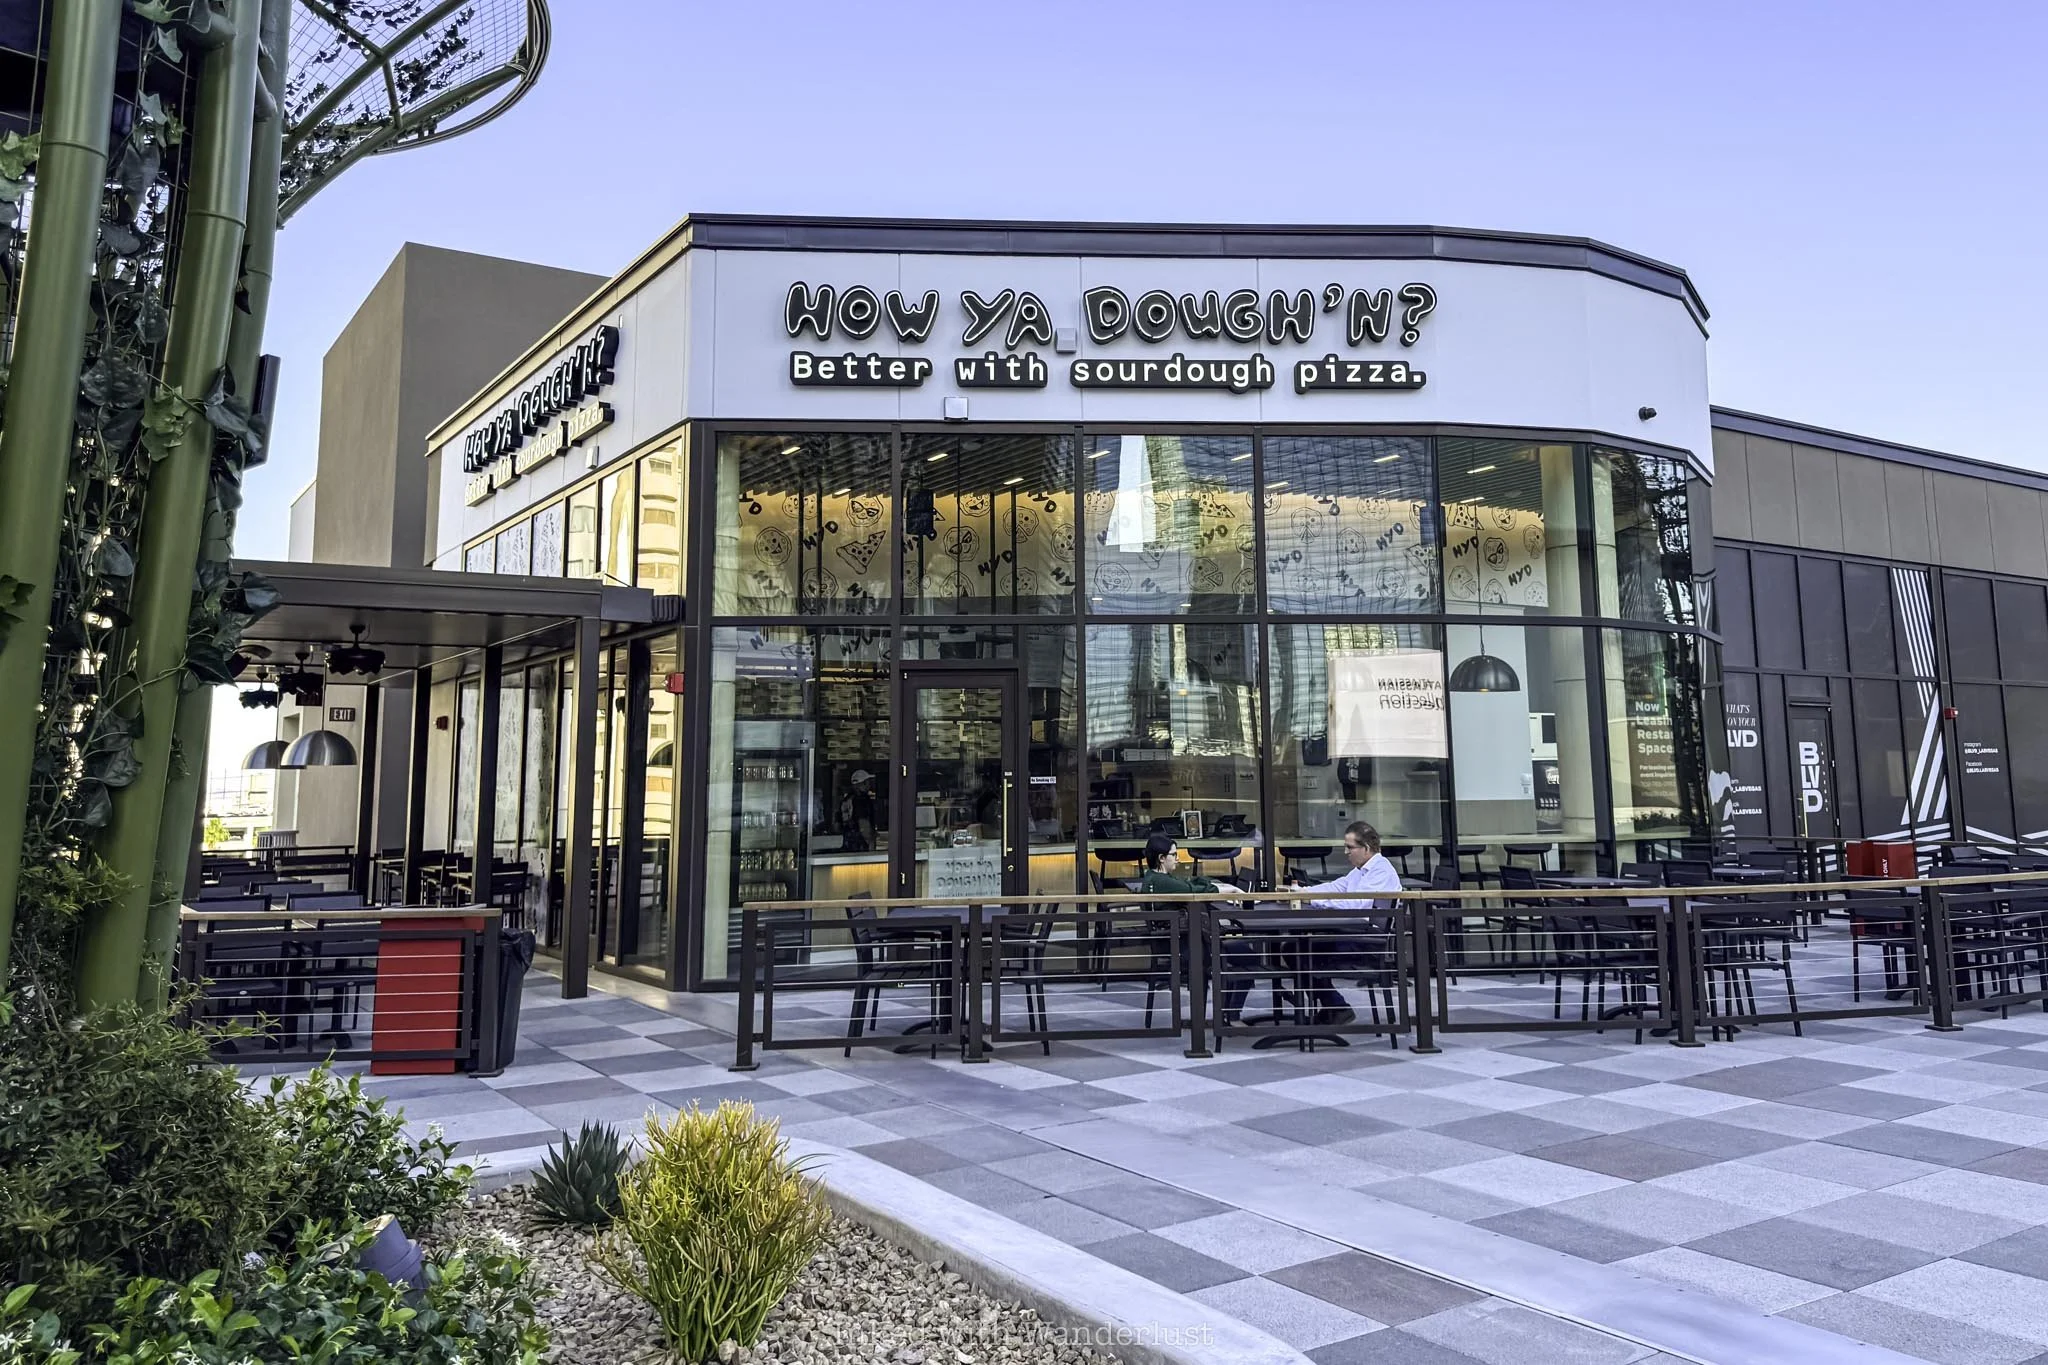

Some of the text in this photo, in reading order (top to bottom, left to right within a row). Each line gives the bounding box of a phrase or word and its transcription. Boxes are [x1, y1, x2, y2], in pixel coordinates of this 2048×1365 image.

[784, 281, 939, 342] HOW
[961, 288, 1053, 351] YA
[793, 353, 1426, 390] Better with sourdough pizza.
[1635, 701, 1660, 712] Now
[333, 709, 351, 720] EXIT
[1636, 715, 1673, 726] Leasin
[1726, 729, 1758, 748] LVD
